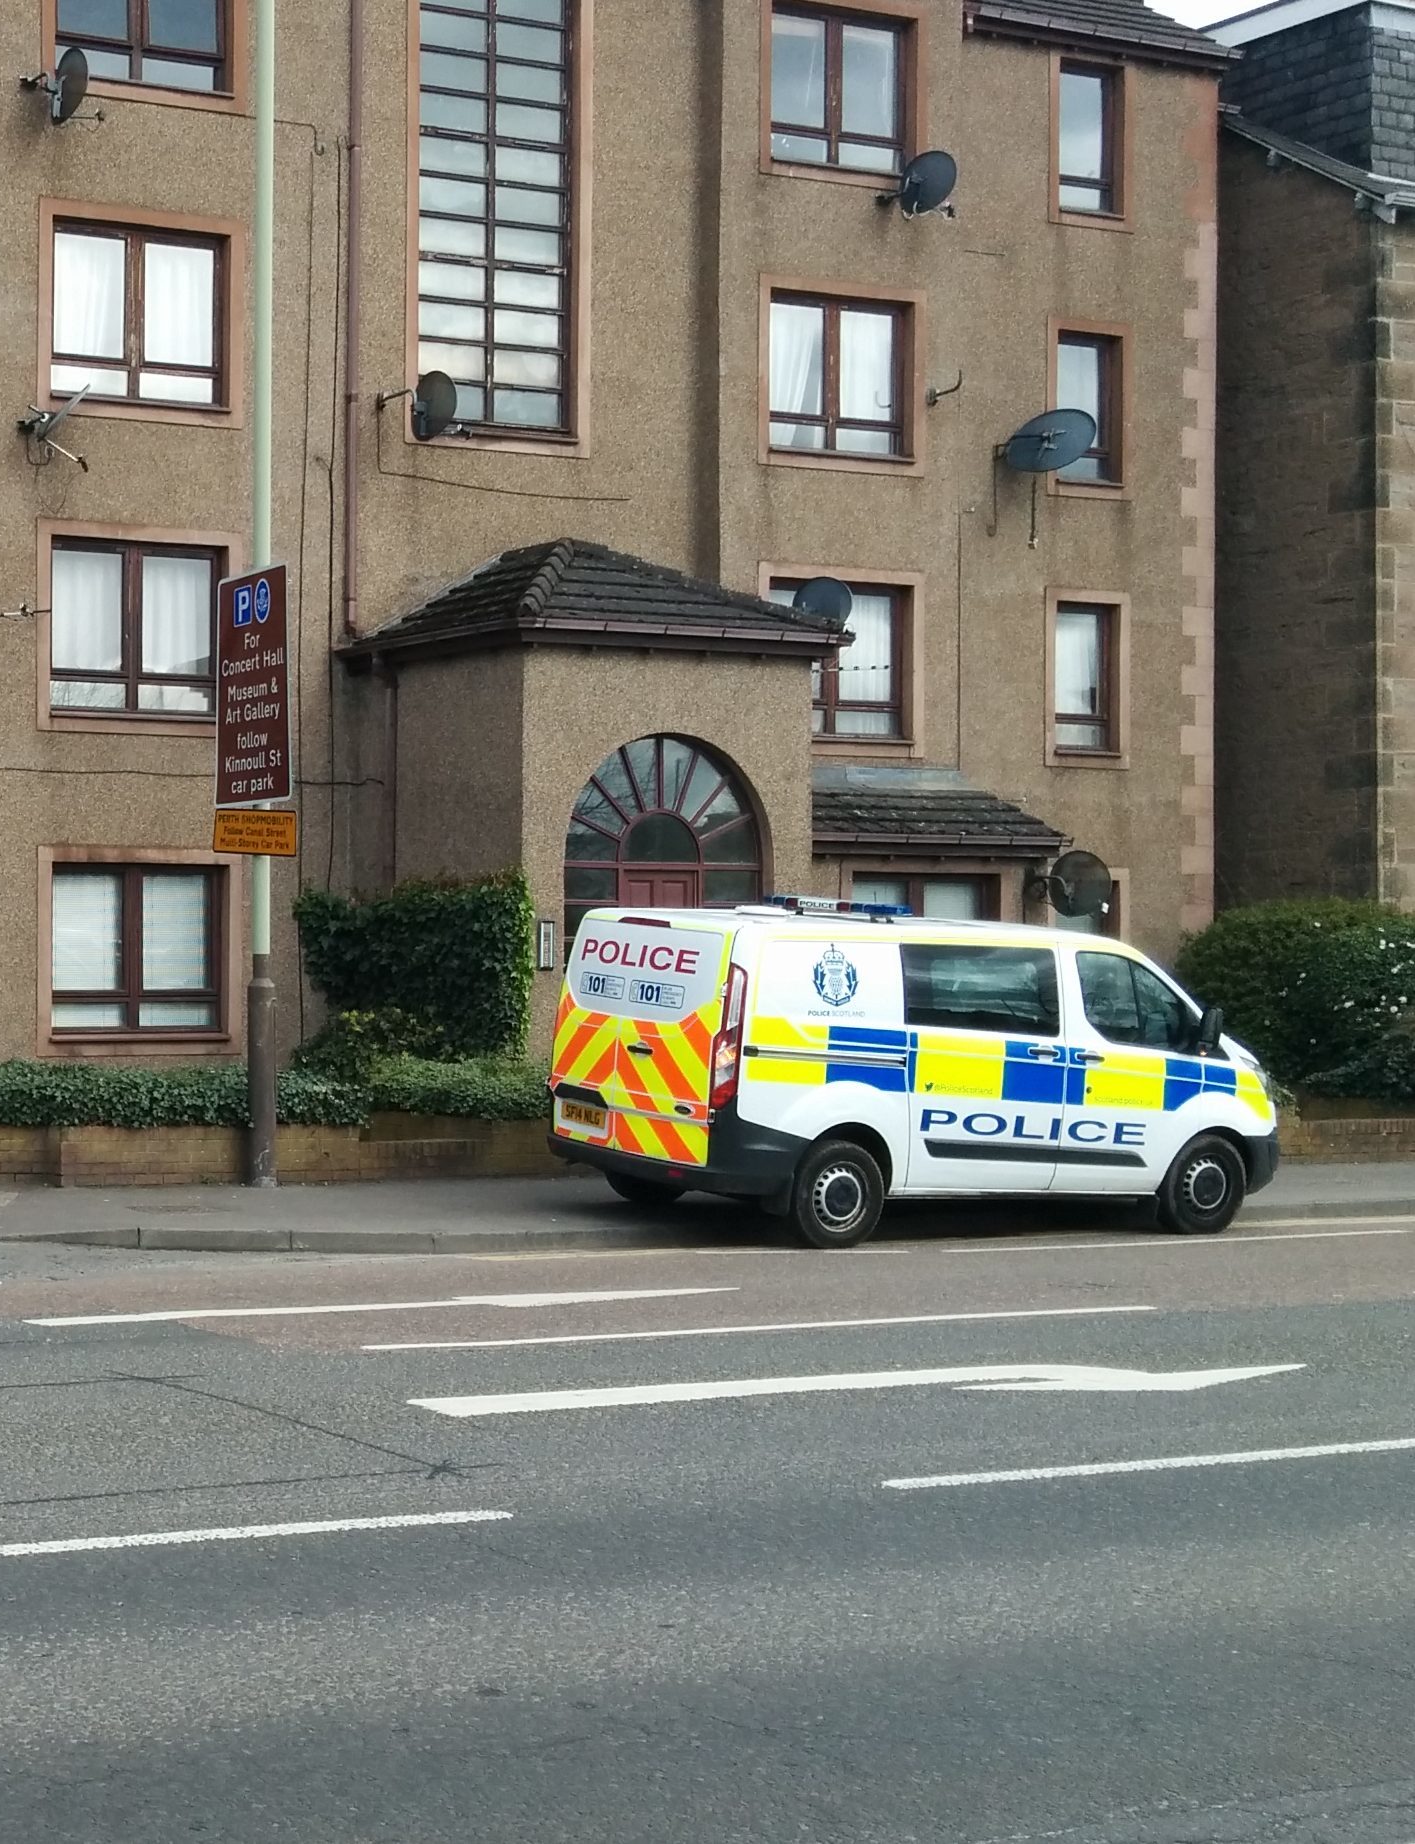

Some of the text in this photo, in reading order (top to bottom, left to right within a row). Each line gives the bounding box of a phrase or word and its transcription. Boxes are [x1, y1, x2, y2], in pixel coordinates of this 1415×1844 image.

[238, 590, 250, 622] P
[244, 633, 260, 650] For
[221, 647, 284, 677] Concert Hall
[227, 676, 278, 703] Museum &
[225, 701, 280, 725] Art Gallery
[237, 731, 268, 750] follow
[225, 748, 282, 774] Kinnoull St
[231, 772, 274, 795] car park
[217, 813, 293, 826] PERTH SHOPMOBILITY
[224, 826, 244, 836] Follow
[266, 827, 286, 838] Street
[220, 837, 290, 850] Multi-Storey Car Park
[799, 899, 834, 909] POLICE
[581, 938, 700, 975] POLICE
[587, 975, 606, 994] 101
[639, 983, 661, 1003] 101
[831, 1010, 866, 1018] SCOTLAND
[920, 1109, 1147, 1146] POLICE
